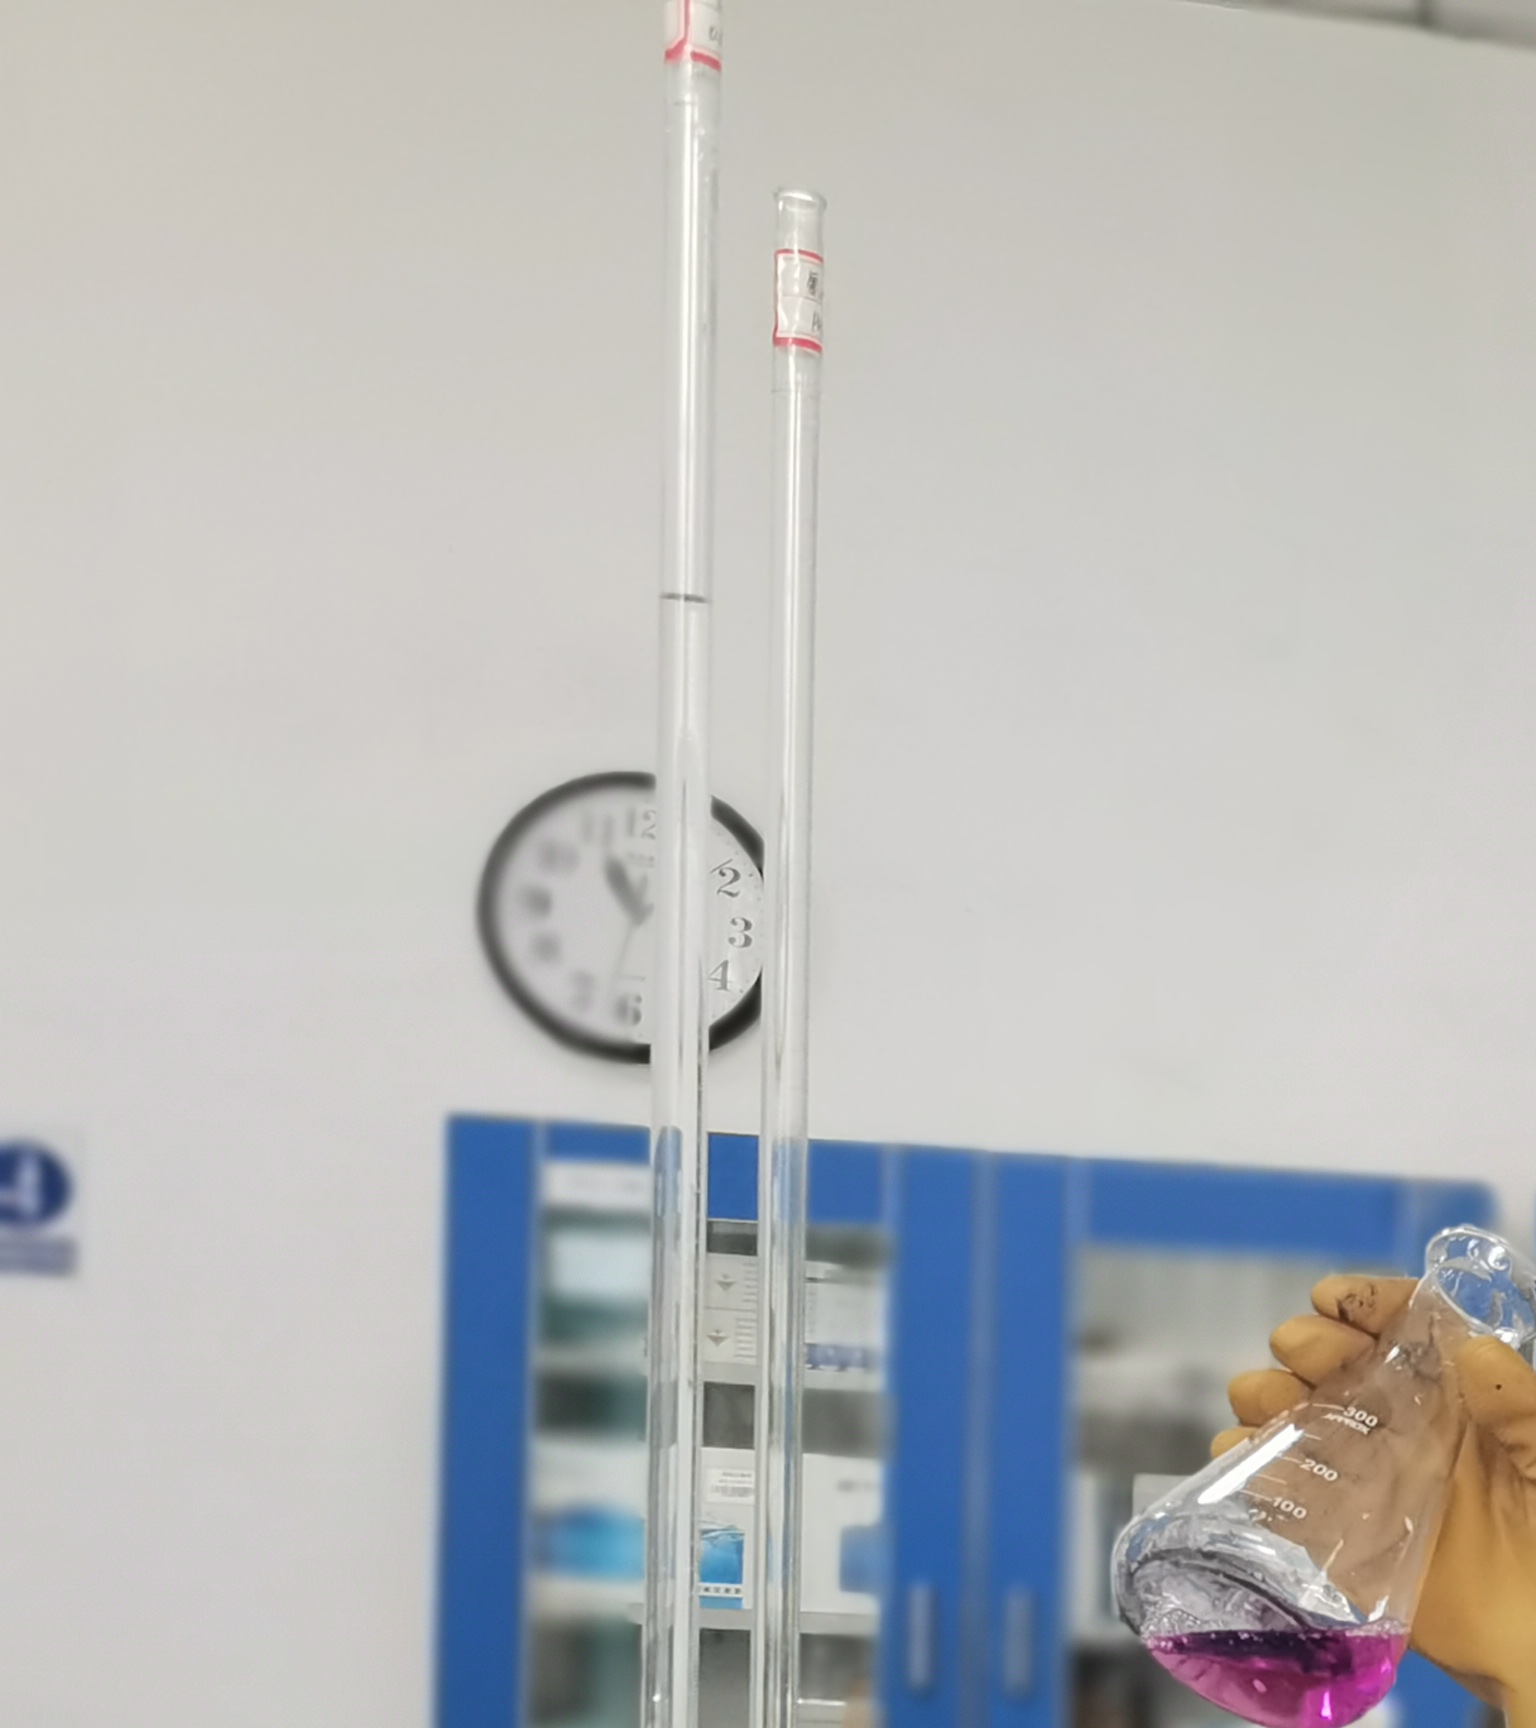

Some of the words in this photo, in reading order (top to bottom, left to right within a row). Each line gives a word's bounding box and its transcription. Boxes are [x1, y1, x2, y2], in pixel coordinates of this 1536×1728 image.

[716, 867, 741, 898] 2
[727, 916, 753, 949] 3
[708, 958, 732, 992] 4
[1343, 1406, 1378, 1427] 300
[1300, 1458, 1338, 1481] 200
[1273, 1497, 1307, 1519] 100
